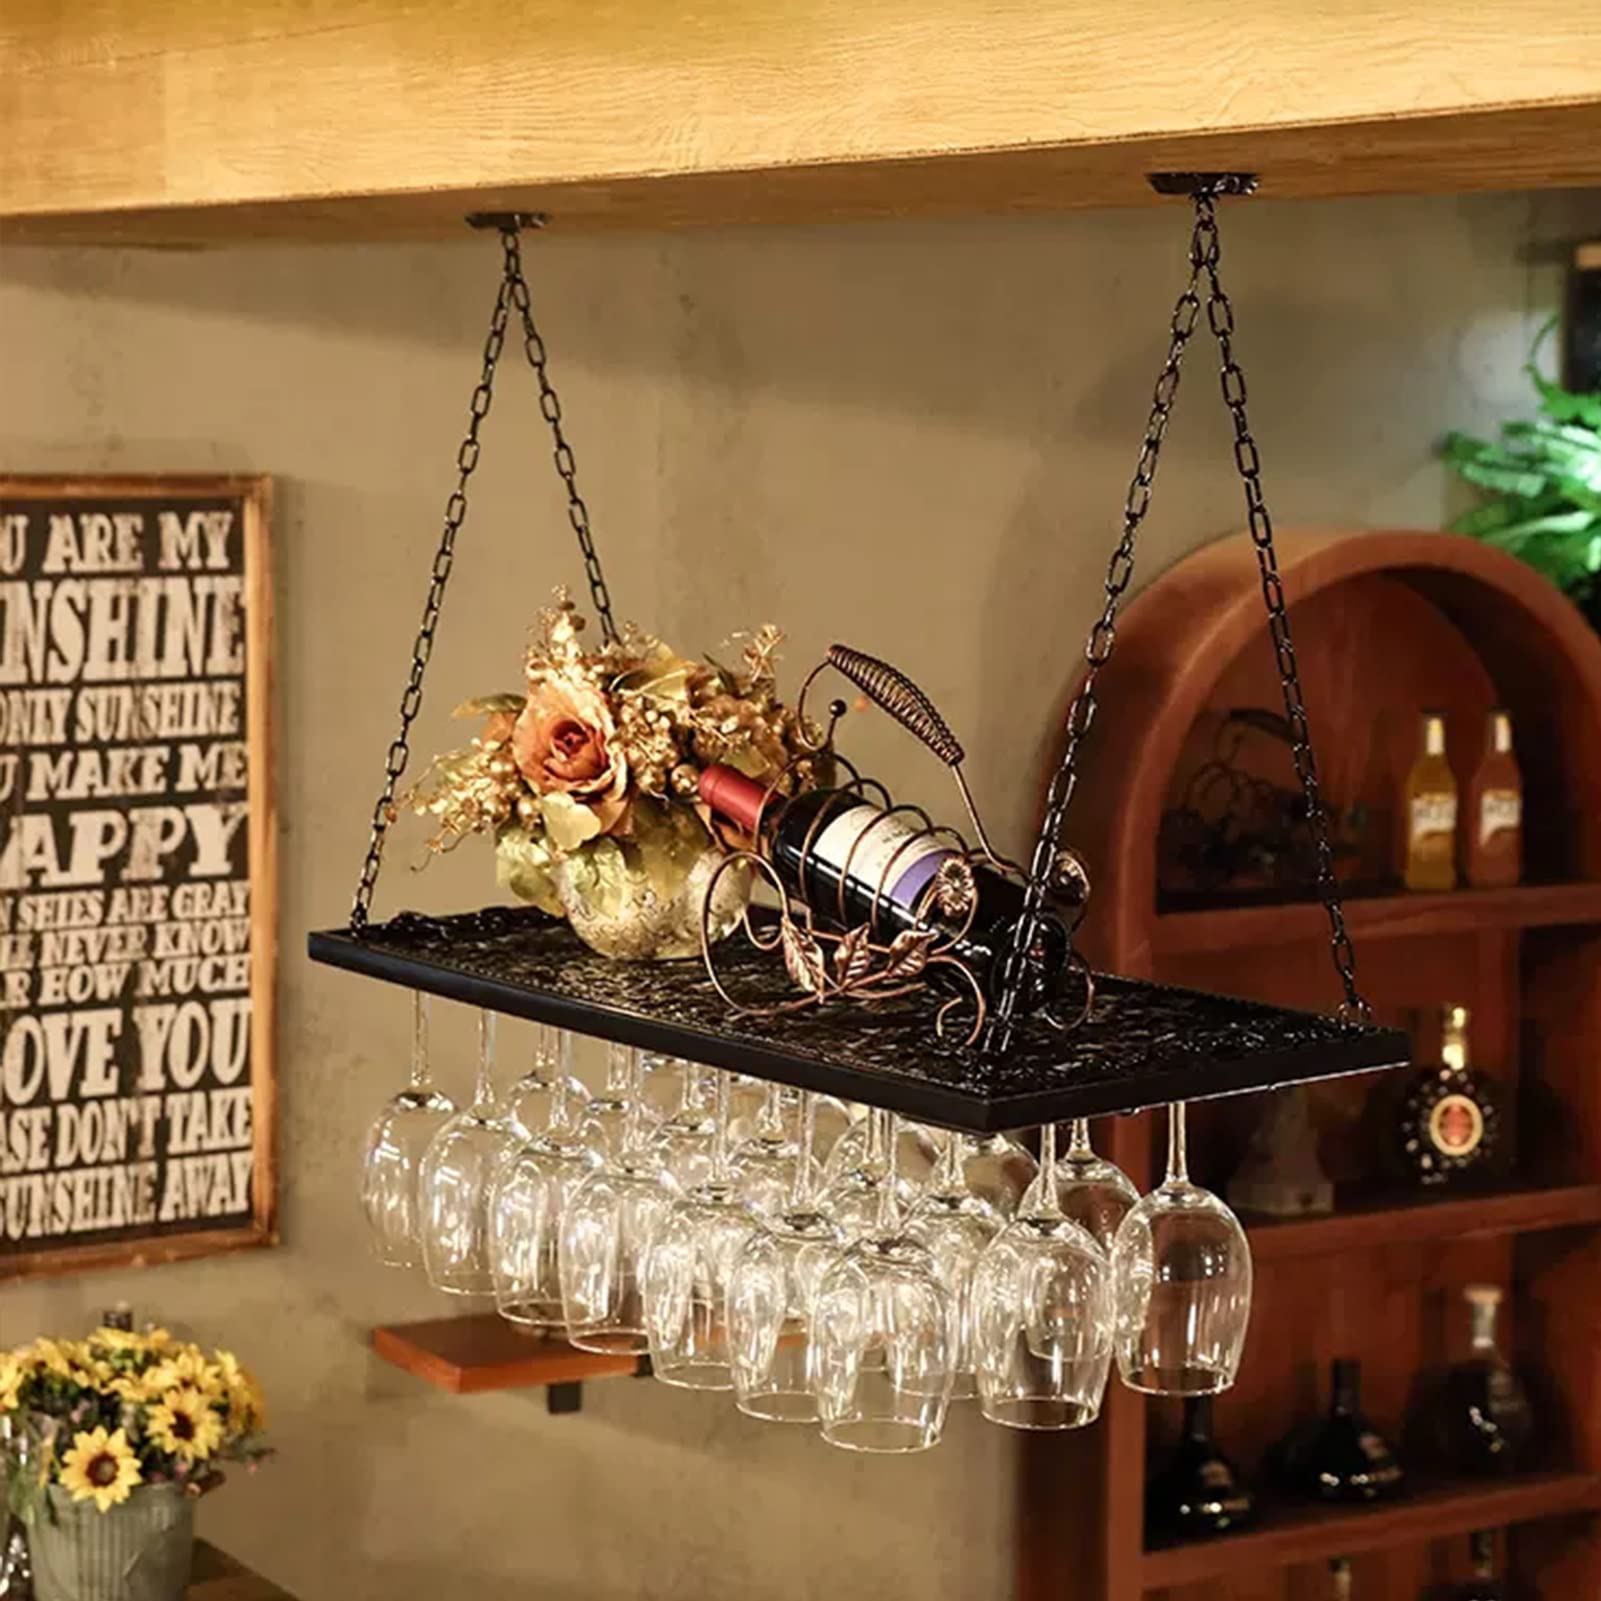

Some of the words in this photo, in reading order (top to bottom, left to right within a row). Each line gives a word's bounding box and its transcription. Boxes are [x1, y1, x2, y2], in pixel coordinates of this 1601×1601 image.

[42, 513, 144, 573] ARE
[158, 511, 234, 569] MY
[0, 576, 245, 684] NSHINE
[75, 683, 240, 741] SUNSHINE
[26, 747, 169, 801] MAKE
[176, 744, 248, 791] ME
[0, 803, 249, 889] APPY
[106, 885, 169, 924] ARE
[171, 880, 251, 919] GRAY
[39, 924, 148, 968] NEVER
[152, 917, 251, 958] KNOW
[37, 963, 131, 1006] HOW
[134, 954, 250, 998] MUCH
[132, 999, 252, 1090] YOU
[55, 1097, 161, 1167] DON'T
[165, 1086, 253, 1154] TAKE
[0, 1161, 158, 1240] UNSHINE
[158, 1152, 253, 1222] AWAY
